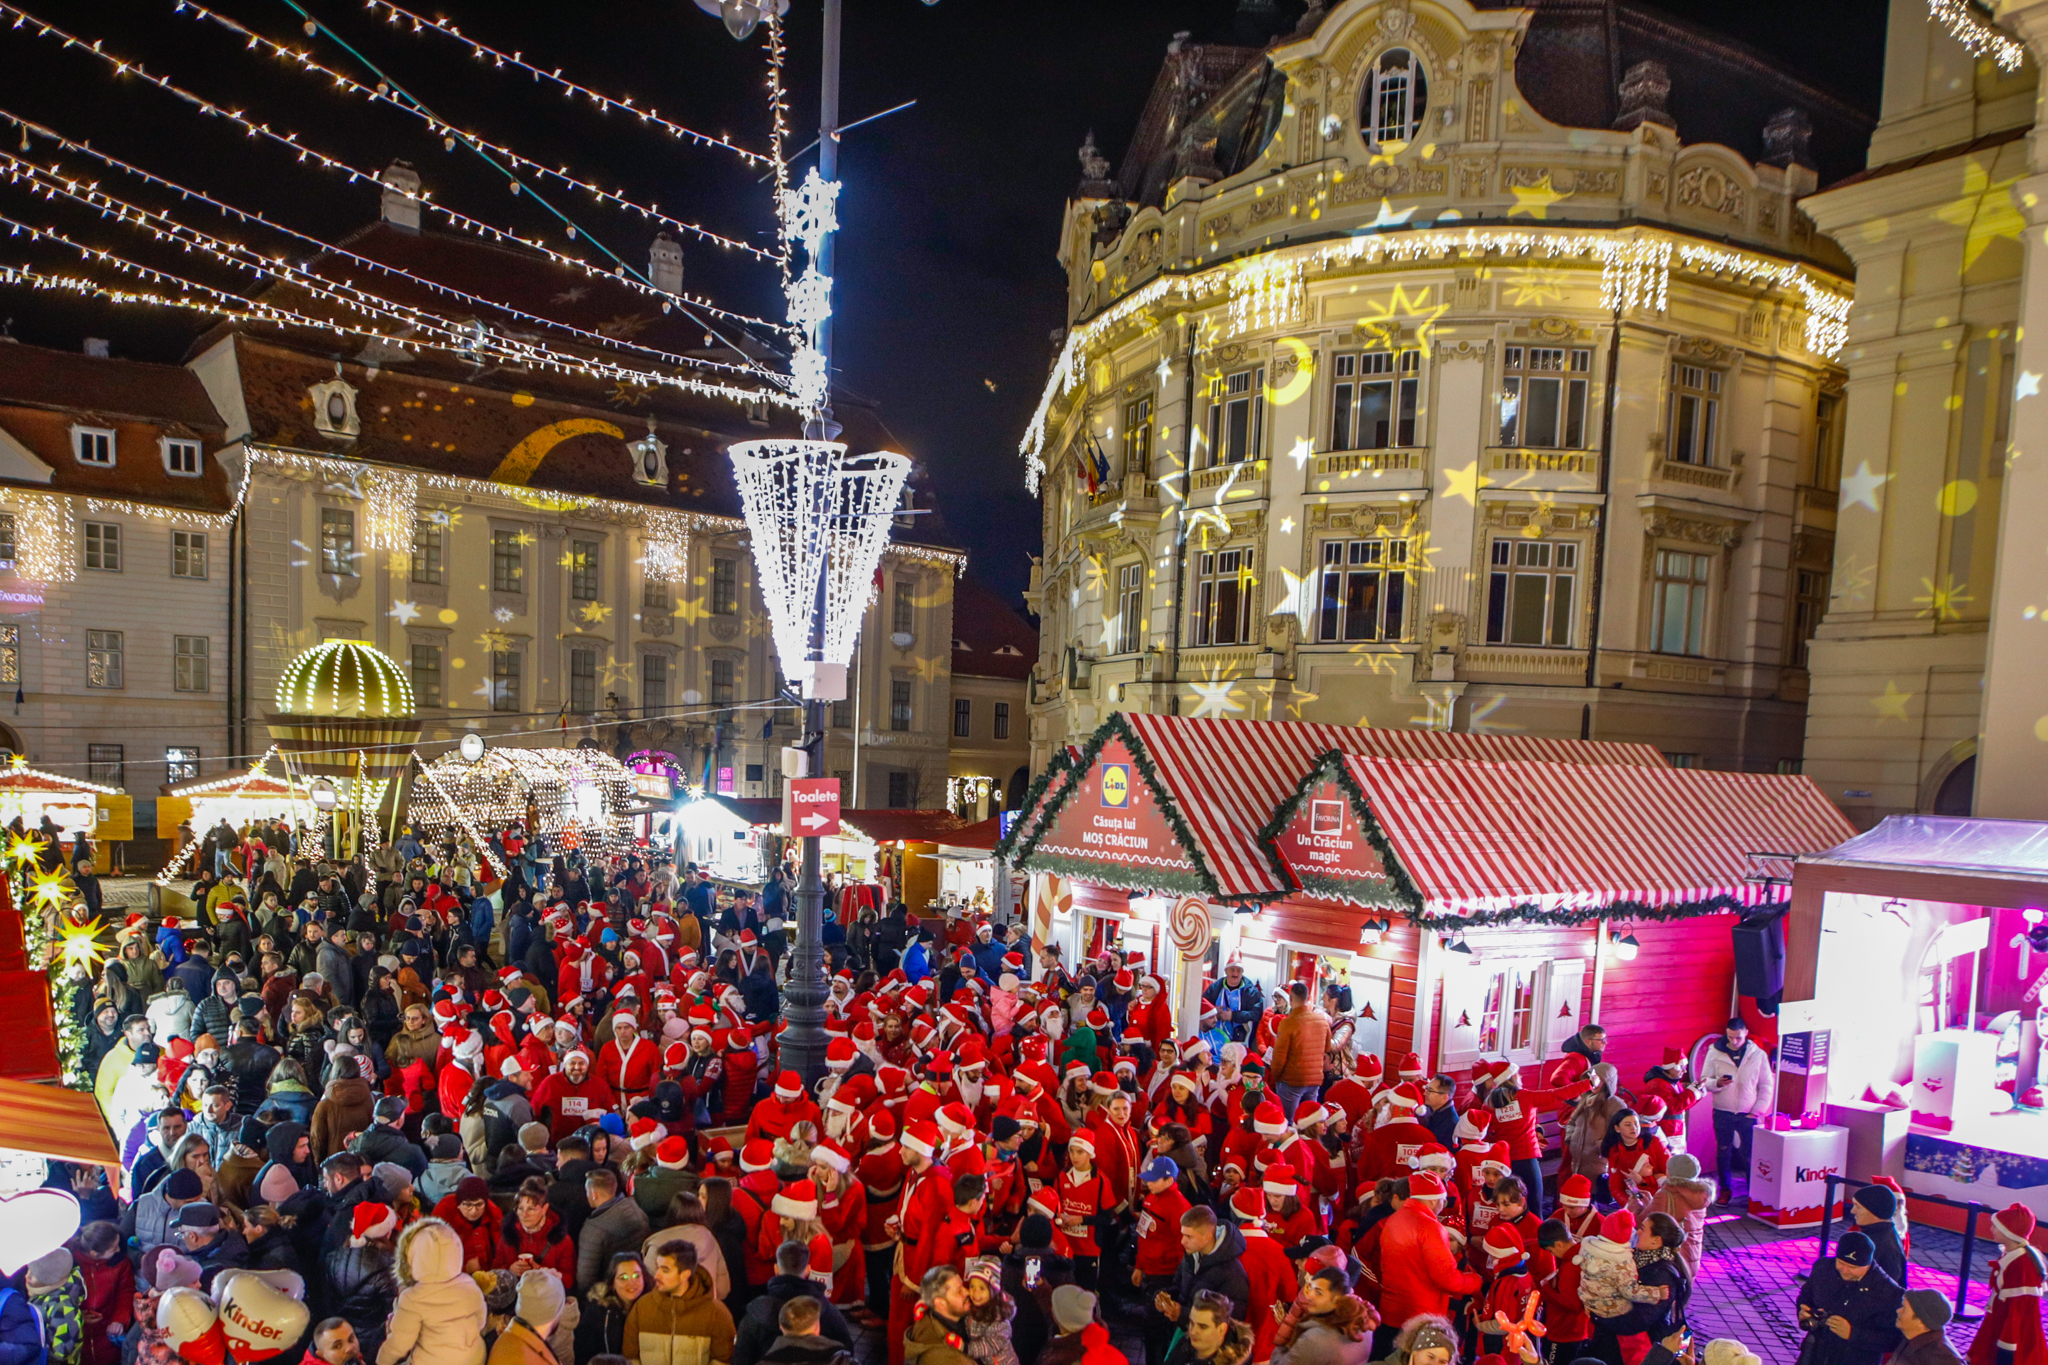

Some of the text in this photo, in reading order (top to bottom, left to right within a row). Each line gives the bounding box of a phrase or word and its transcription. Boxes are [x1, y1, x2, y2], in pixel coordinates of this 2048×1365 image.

[792, 789, 838, 803] Toalete
[1093, 815, 1136, 831] Căsuța lui
[1315, 813, 1340, 823] FAVORINA
[1083, 831, 1148, 849] MOȘ CRĂCIUN
[1297, 834, 1353, 850] Un Crăciun
[1309, 850, 1341, 864] magic
[1500, 1105, 1515, 1114] 128
